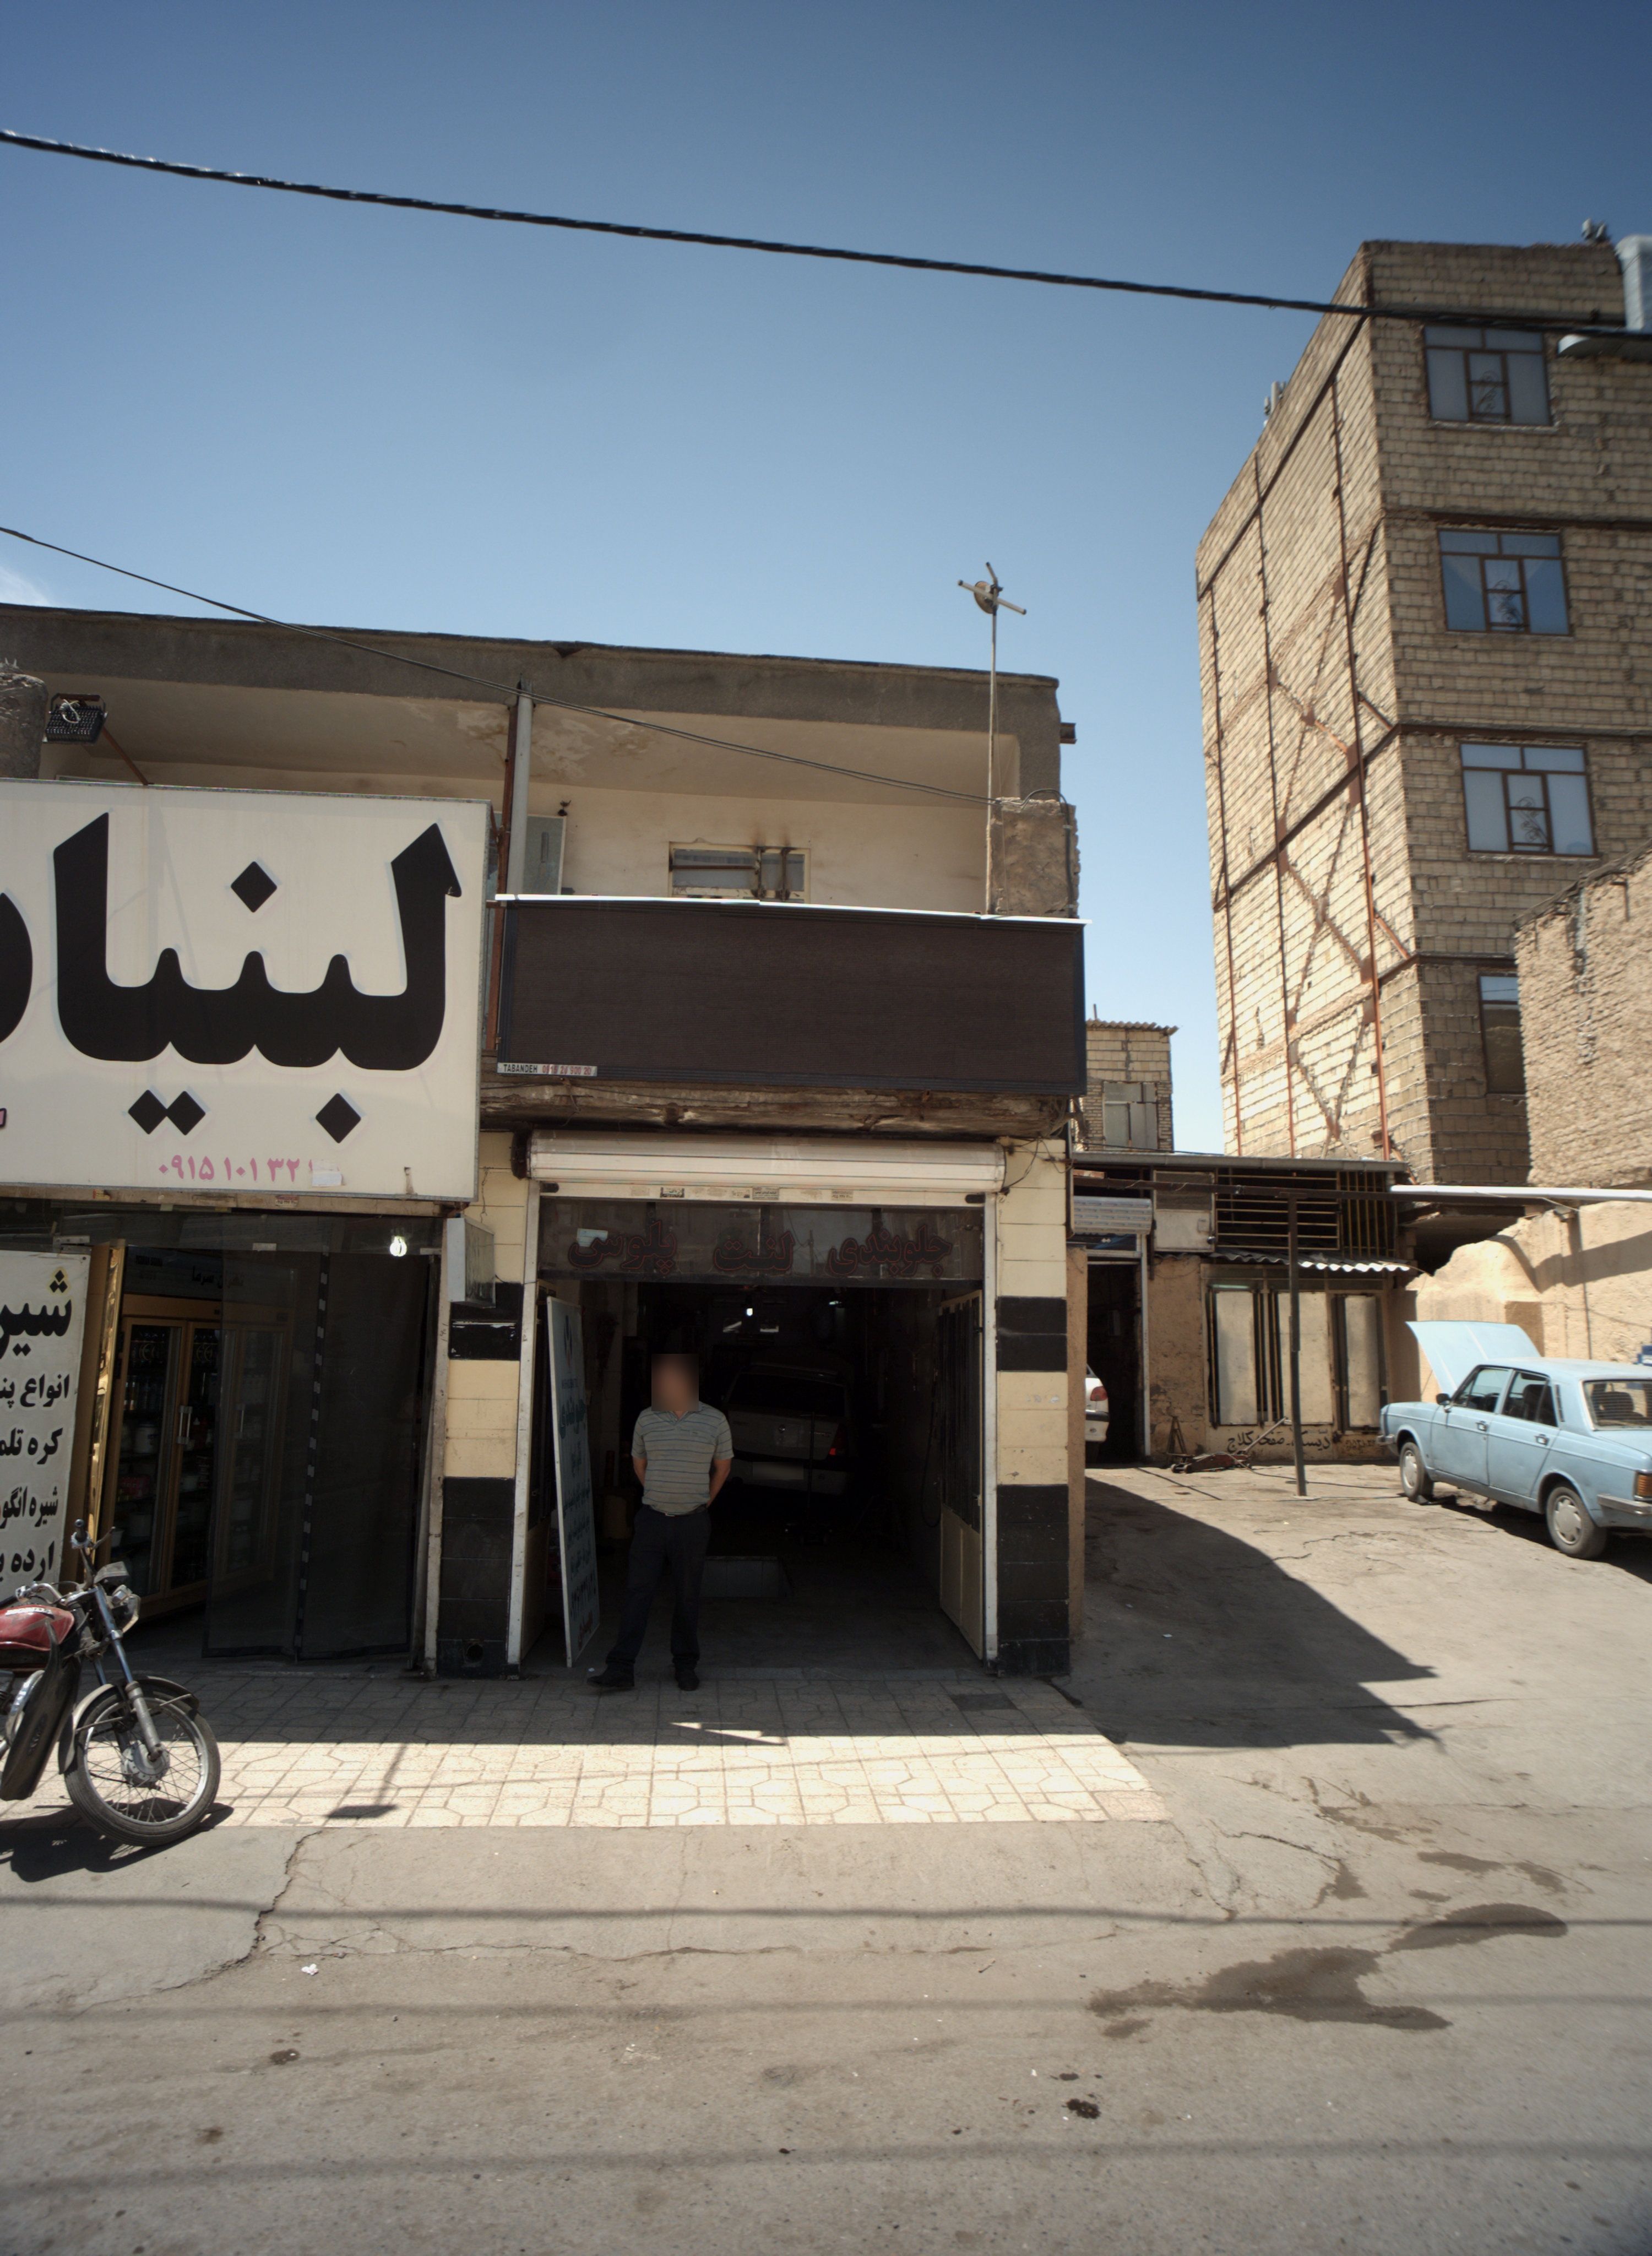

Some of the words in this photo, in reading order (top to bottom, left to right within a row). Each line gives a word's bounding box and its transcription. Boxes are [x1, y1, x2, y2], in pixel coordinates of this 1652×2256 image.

[0, 812, 463, 1144] لبنیا
[503, 1064, 538, 1073] TABANDEH
[158, 1154, 215, 1180] ۰۹۱۵
[568, 1220, 678, 1276] پلوس
[714, 1230, 794, 1271] لنت
[829, 1224, 953, 1276] جلوبندی
[0, 1378, 15, 1409] پن
[20, 1374, 70, 1407] انواع
[0, 1428, 24, 1456] تلم
[28, 1428, 63, 1465] کره
[0, 1486, 28, 1529] انگو
[29, 1486, 58, 1527] شیره
[11, 1541, 55, 1581] ارده
